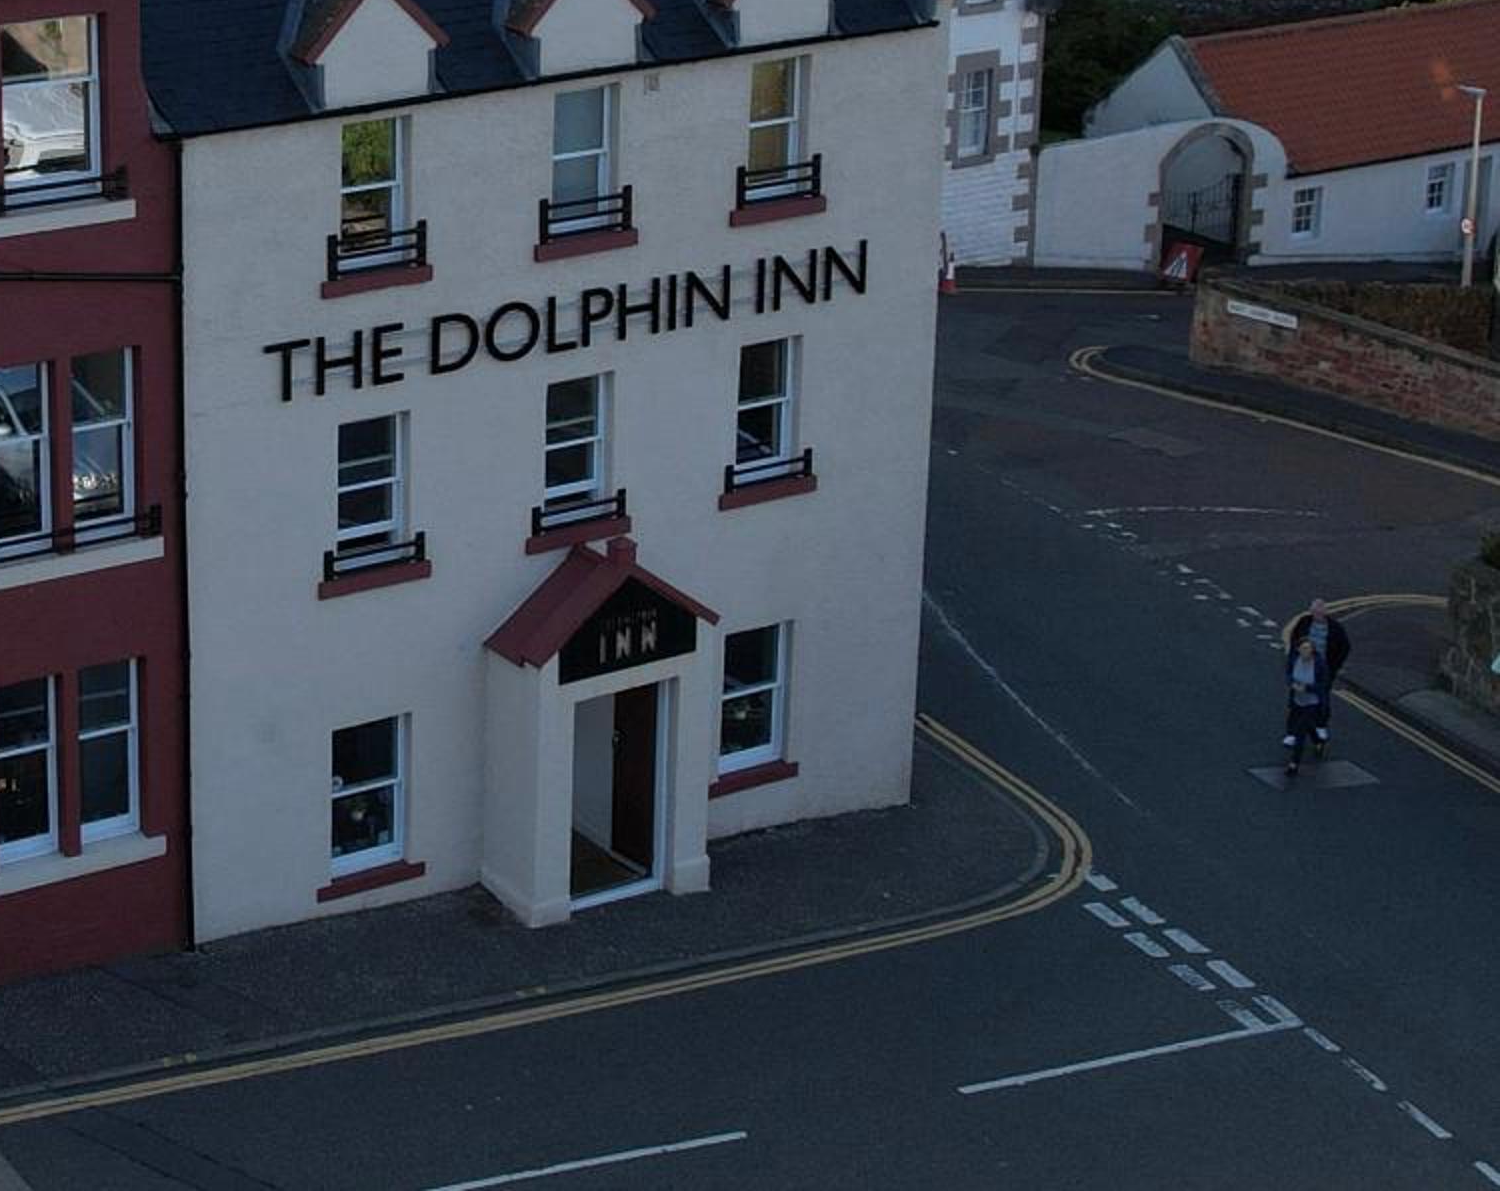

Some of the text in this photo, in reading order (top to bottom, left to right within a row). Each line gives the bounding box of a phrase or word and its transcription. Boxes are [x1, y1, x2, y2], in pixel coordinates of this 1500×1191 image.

[263, 239, 868, 402] THE DOLPHIN INN
[599, 620, 657, 665] INN
